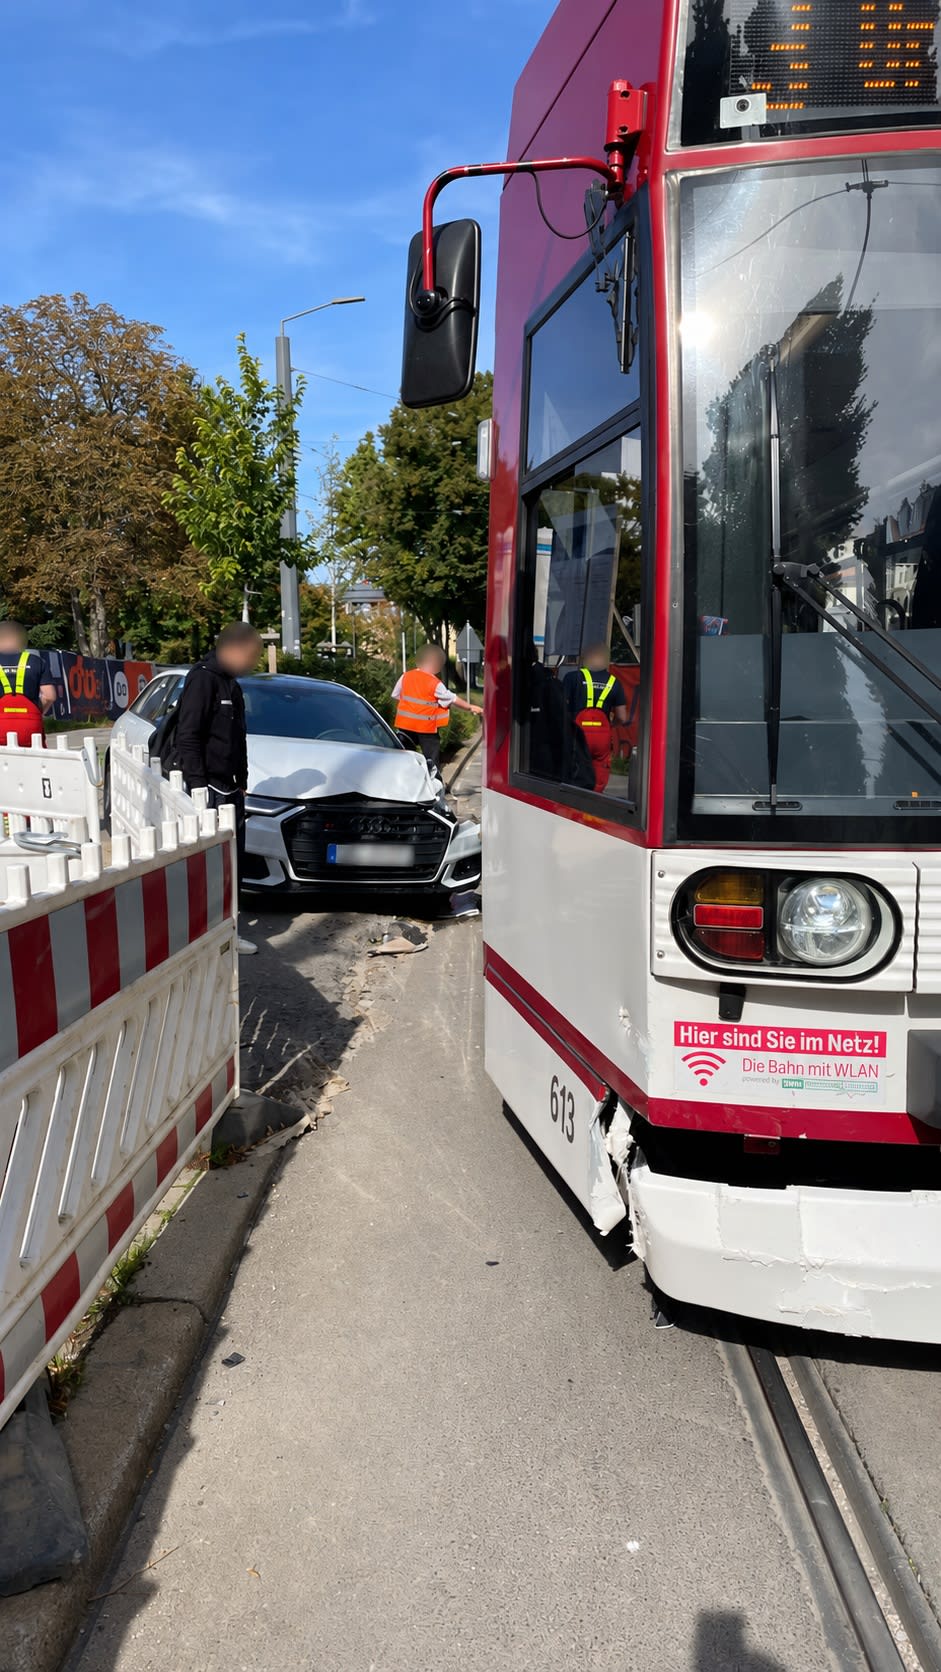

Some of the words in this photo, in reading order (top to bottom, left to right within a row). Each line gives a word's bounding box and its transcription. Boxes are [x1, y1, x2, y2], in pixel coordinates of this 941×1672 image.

[679, 1025, 718, 1045] Hier
[722, 1028, 761, 1048] sind
[766, 1030, 796, 1050] Sie
[800, 1032, 823, 1051] im
[828, 1034, 880, 1054] Netz!
[742, 1058, 765, 1073] Die
[768, 1060, 804, 1075] Bahn
[808, 1062, 831, 1077] mit
[834, 1063, 879, 1078] WLAN
[742, 1076, 770, 1084] powered
[772, 1077, 780, 1086] by
[550, 1074, 575, 1144] 613
